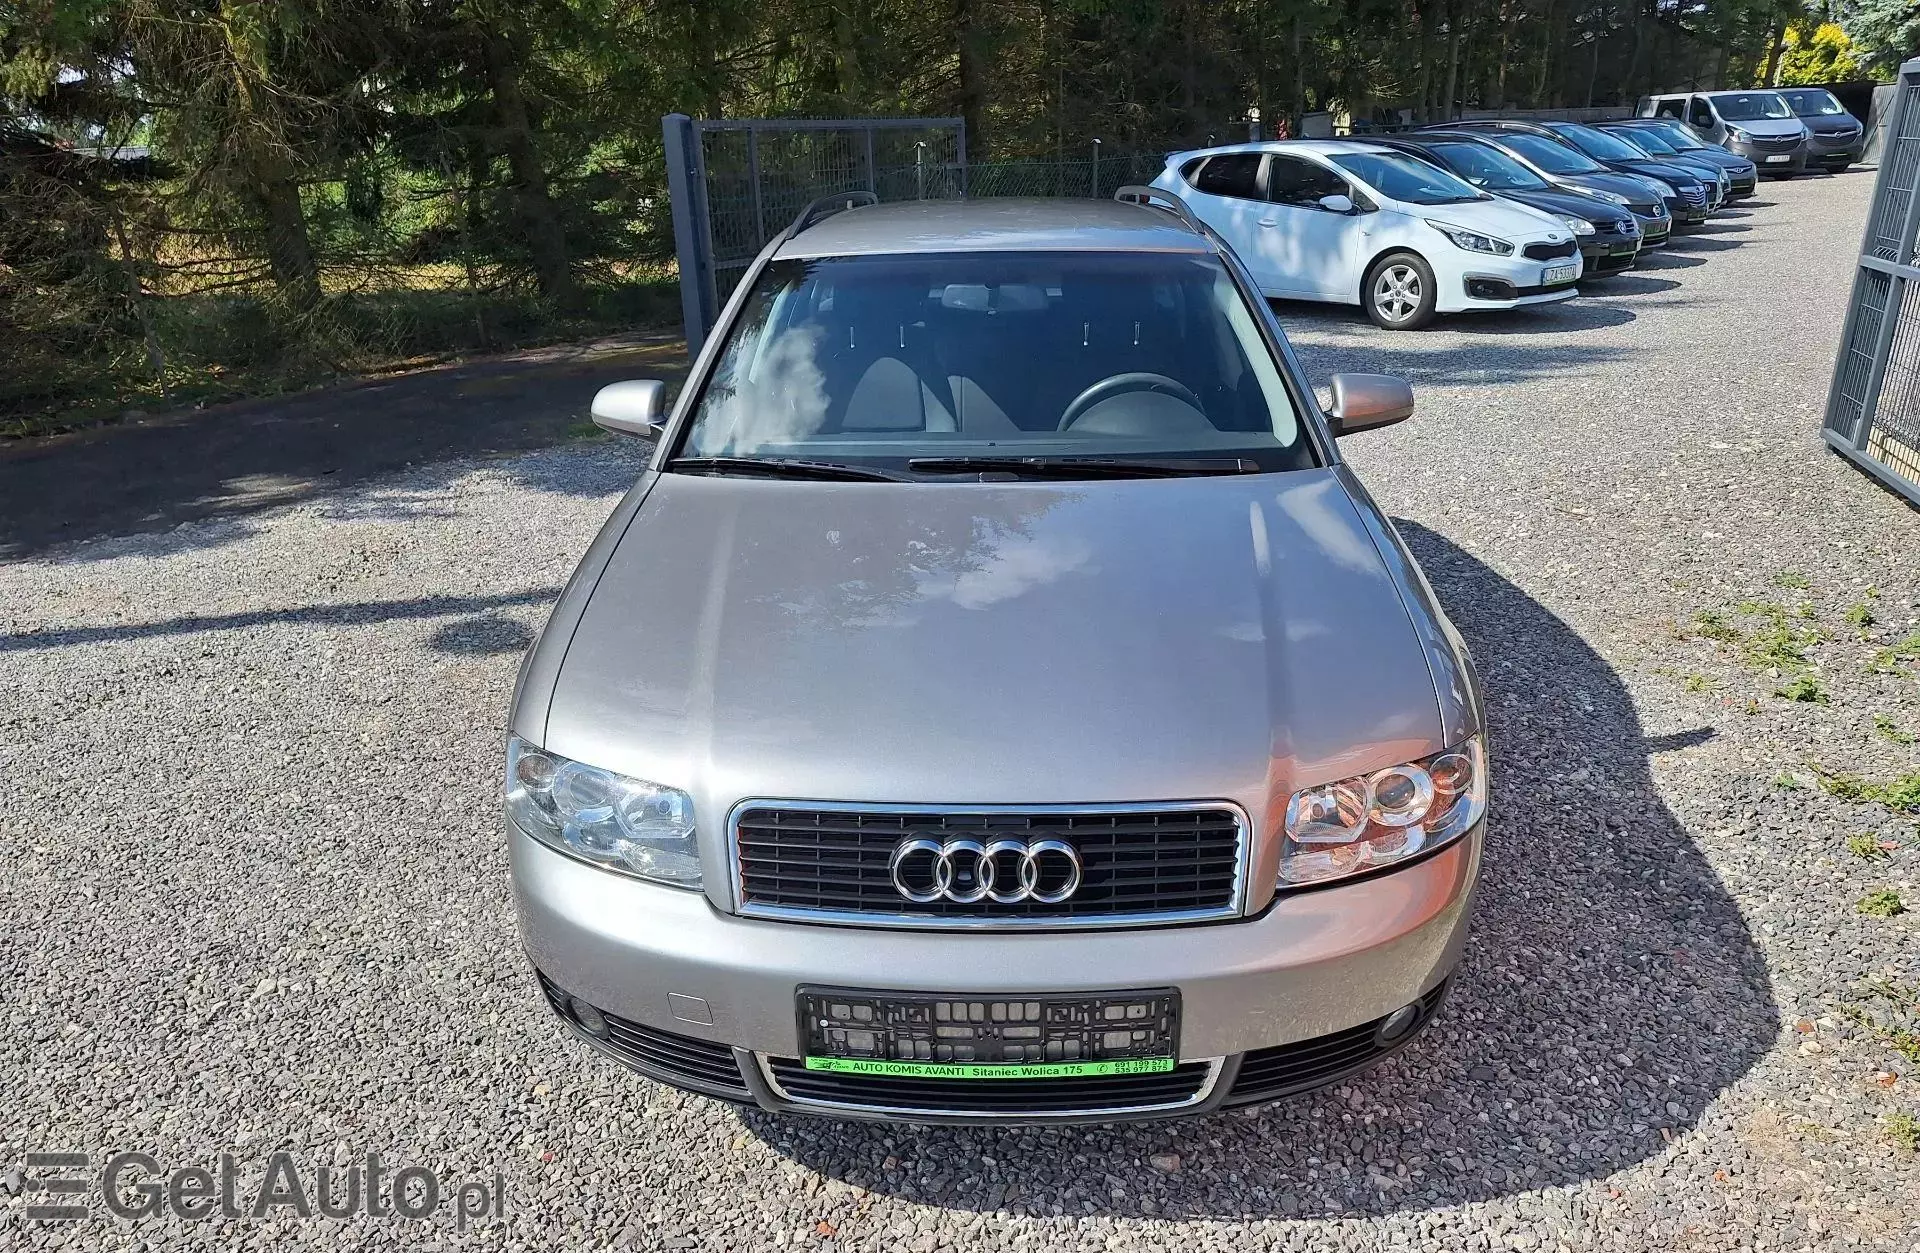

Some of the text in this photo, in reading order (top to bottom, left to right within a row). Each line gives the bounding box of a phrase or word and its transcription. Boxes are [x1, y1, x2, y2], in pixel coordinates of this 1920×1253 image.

[853, 1062, 883, 1072] AUTO
[886, 1064, 922, 1074] KOMIS
[925, 1066, 965, 1076] AVANTI
[972, 1068, 1018, 1076] Sitaniec
[1021, 1067, 1059, 1076] Wolica
[1063, 1066, 1083, 1075] 175
